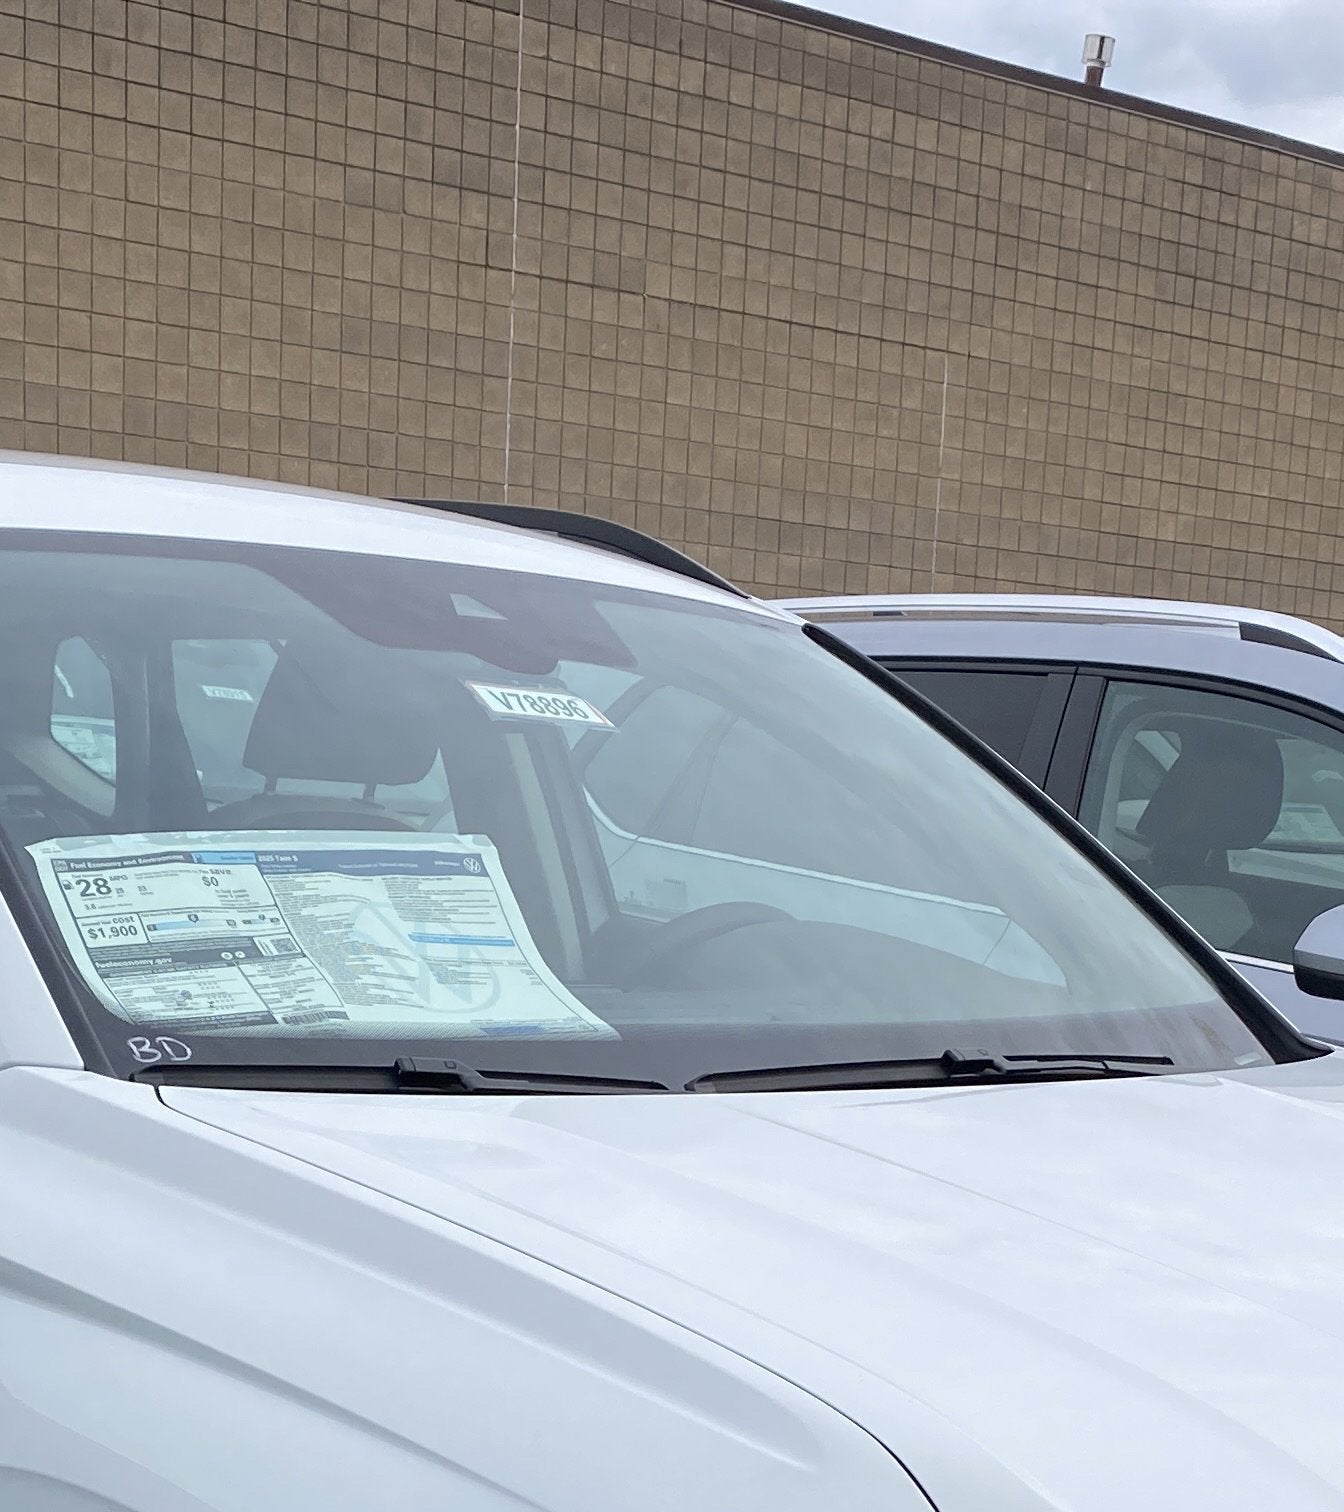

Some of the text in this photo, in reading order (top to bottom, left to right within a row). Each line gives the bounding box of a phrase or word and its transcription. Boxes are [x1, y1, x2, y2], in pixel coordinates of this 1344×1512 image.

[486, 688, 590, 720] V78896
[76, 878, 112, 898] 28
[201, 876, 219, 887] $0
[112, 915, 135, 924] cost
[87, 925, 138, 940] $1,900
[126, 1036, 193, 1063] BD
